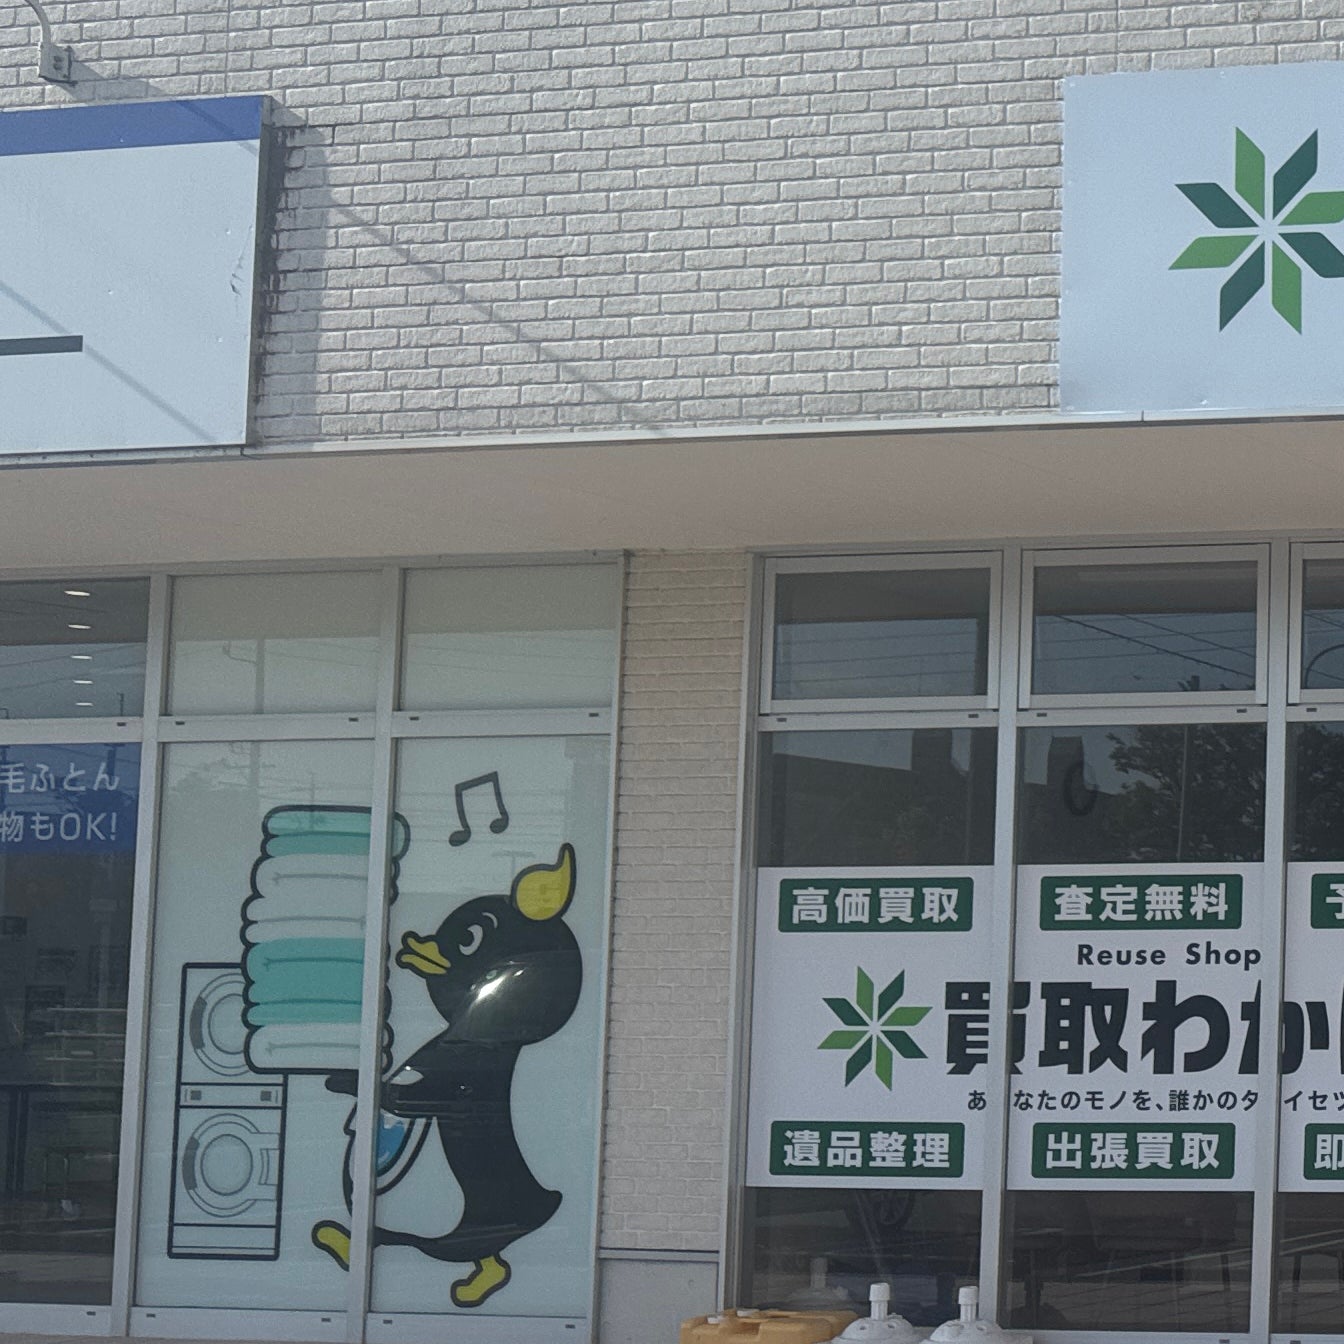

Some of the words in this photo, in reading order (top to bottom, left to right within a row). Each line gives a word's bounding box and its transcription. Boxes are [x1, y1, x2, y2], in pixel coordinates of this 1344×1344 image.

[791, 886, 961, 926] 高価買取
[1053, 883, 1230, 923] 査定無料
[1077, 943, 1167, 967] Reuse
[1185, 942, 1262, 972] Shop
[782, 1129, 952, 1170] 遺品整理
[1045, 1130, 1221, 1171] 出張買取
